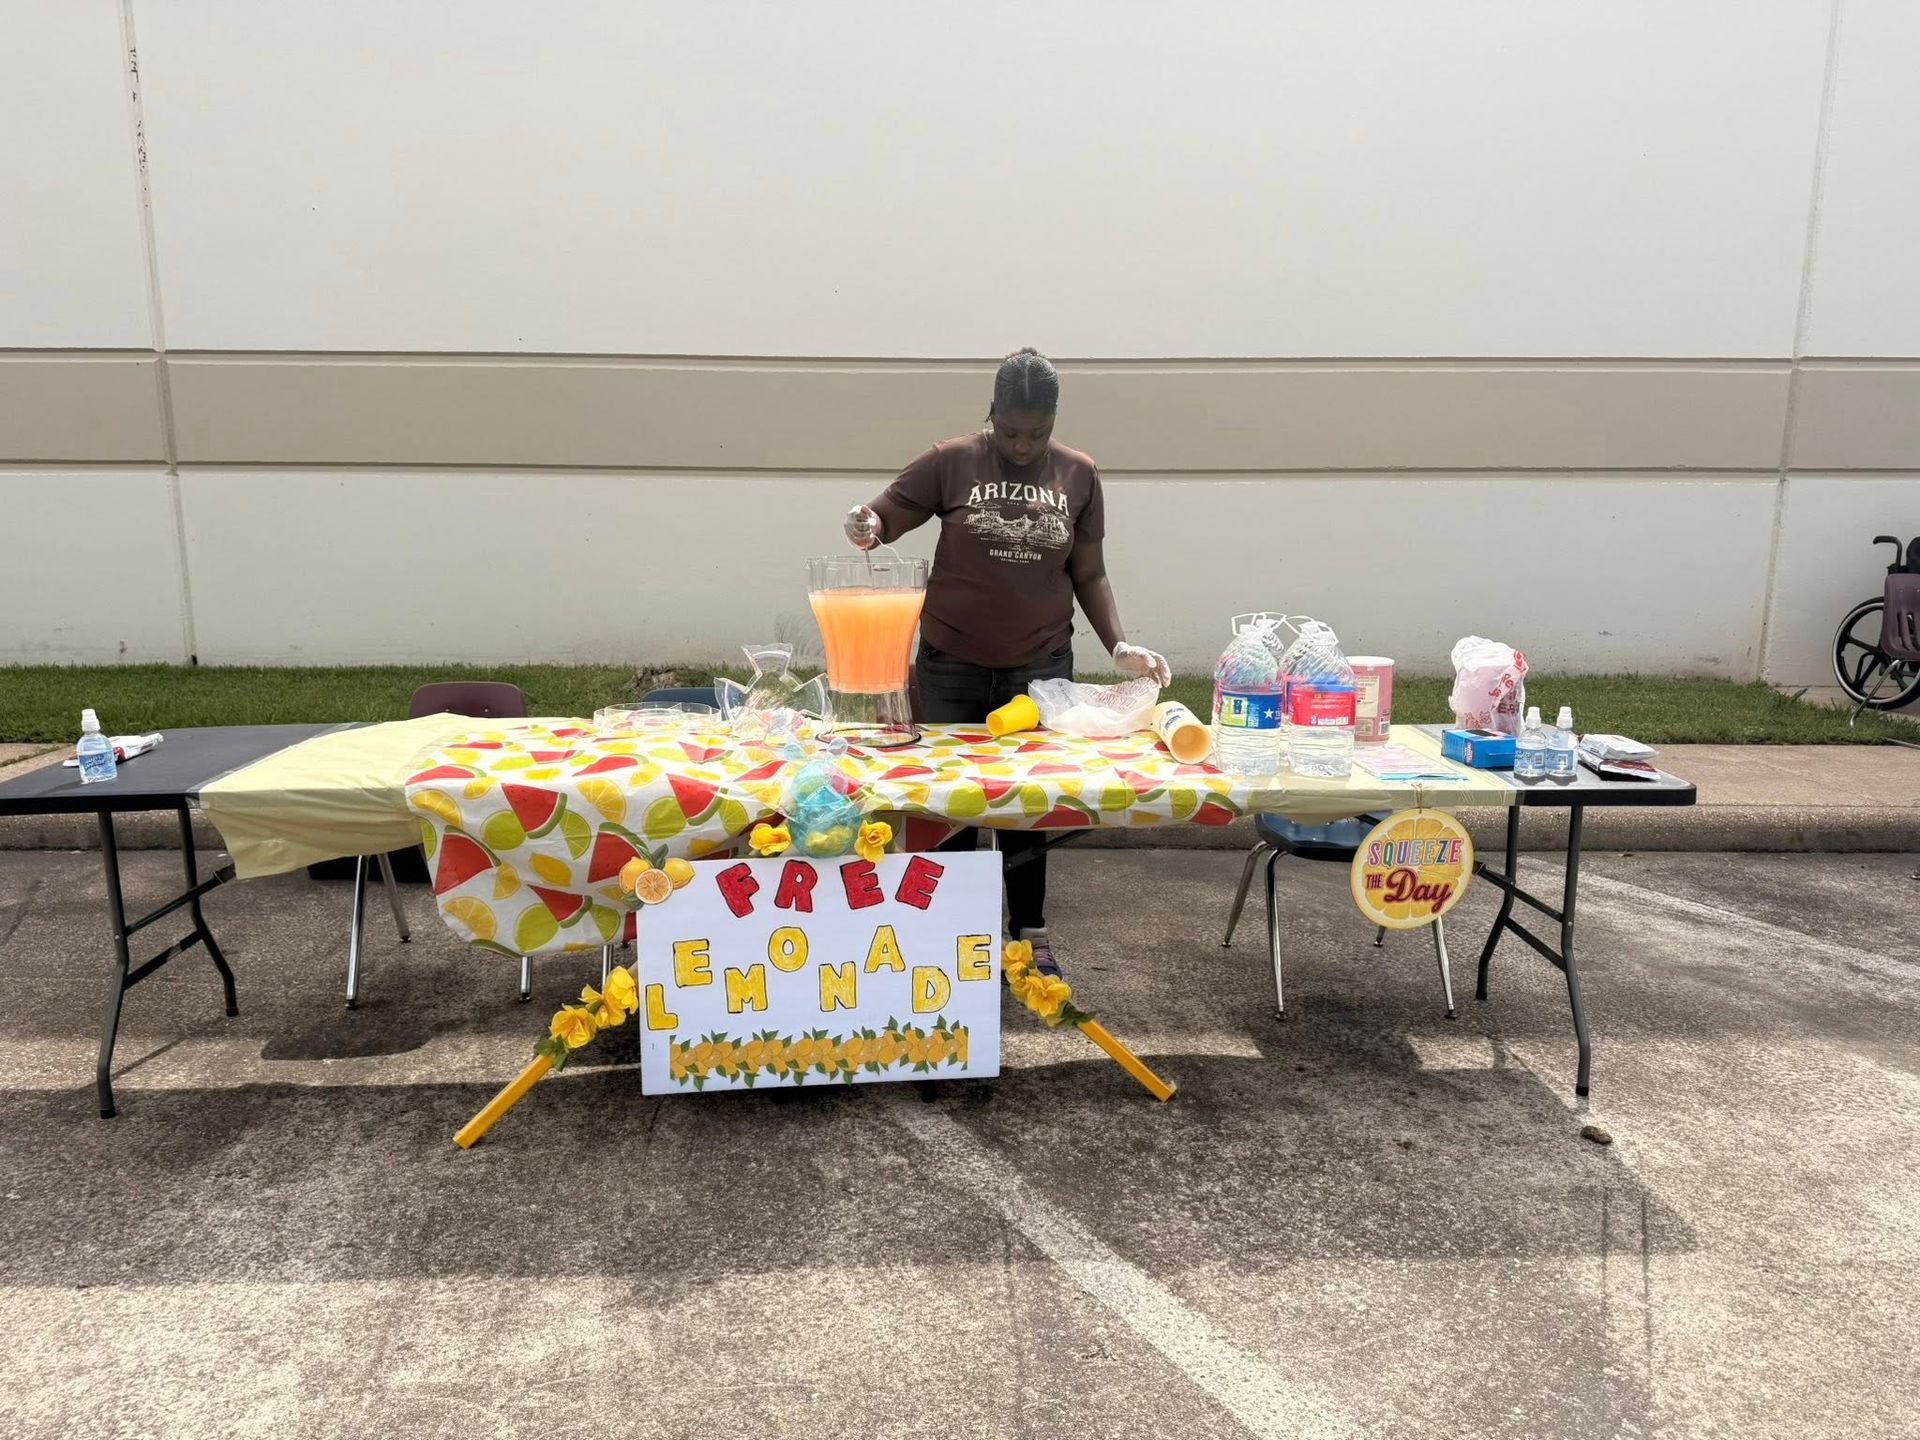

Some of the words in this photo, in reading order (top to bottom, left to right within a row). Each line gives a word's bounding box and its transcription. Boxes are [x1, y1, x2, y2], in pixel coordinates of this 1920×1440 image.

[965, 481, 1070, 516] ARIZONA
[989, 548, 1013, 558] GRAND
[1014, 550, 1042, 561] CANYON
[1368, 838, 1464, 868] SQUEEZE
[716, 855, 945, 918] FREE
[1366, 874, 1383, 889] THE
[1383, 868, 1453, 913] Day
[645, 924, 992, 1030] LEMONADE
